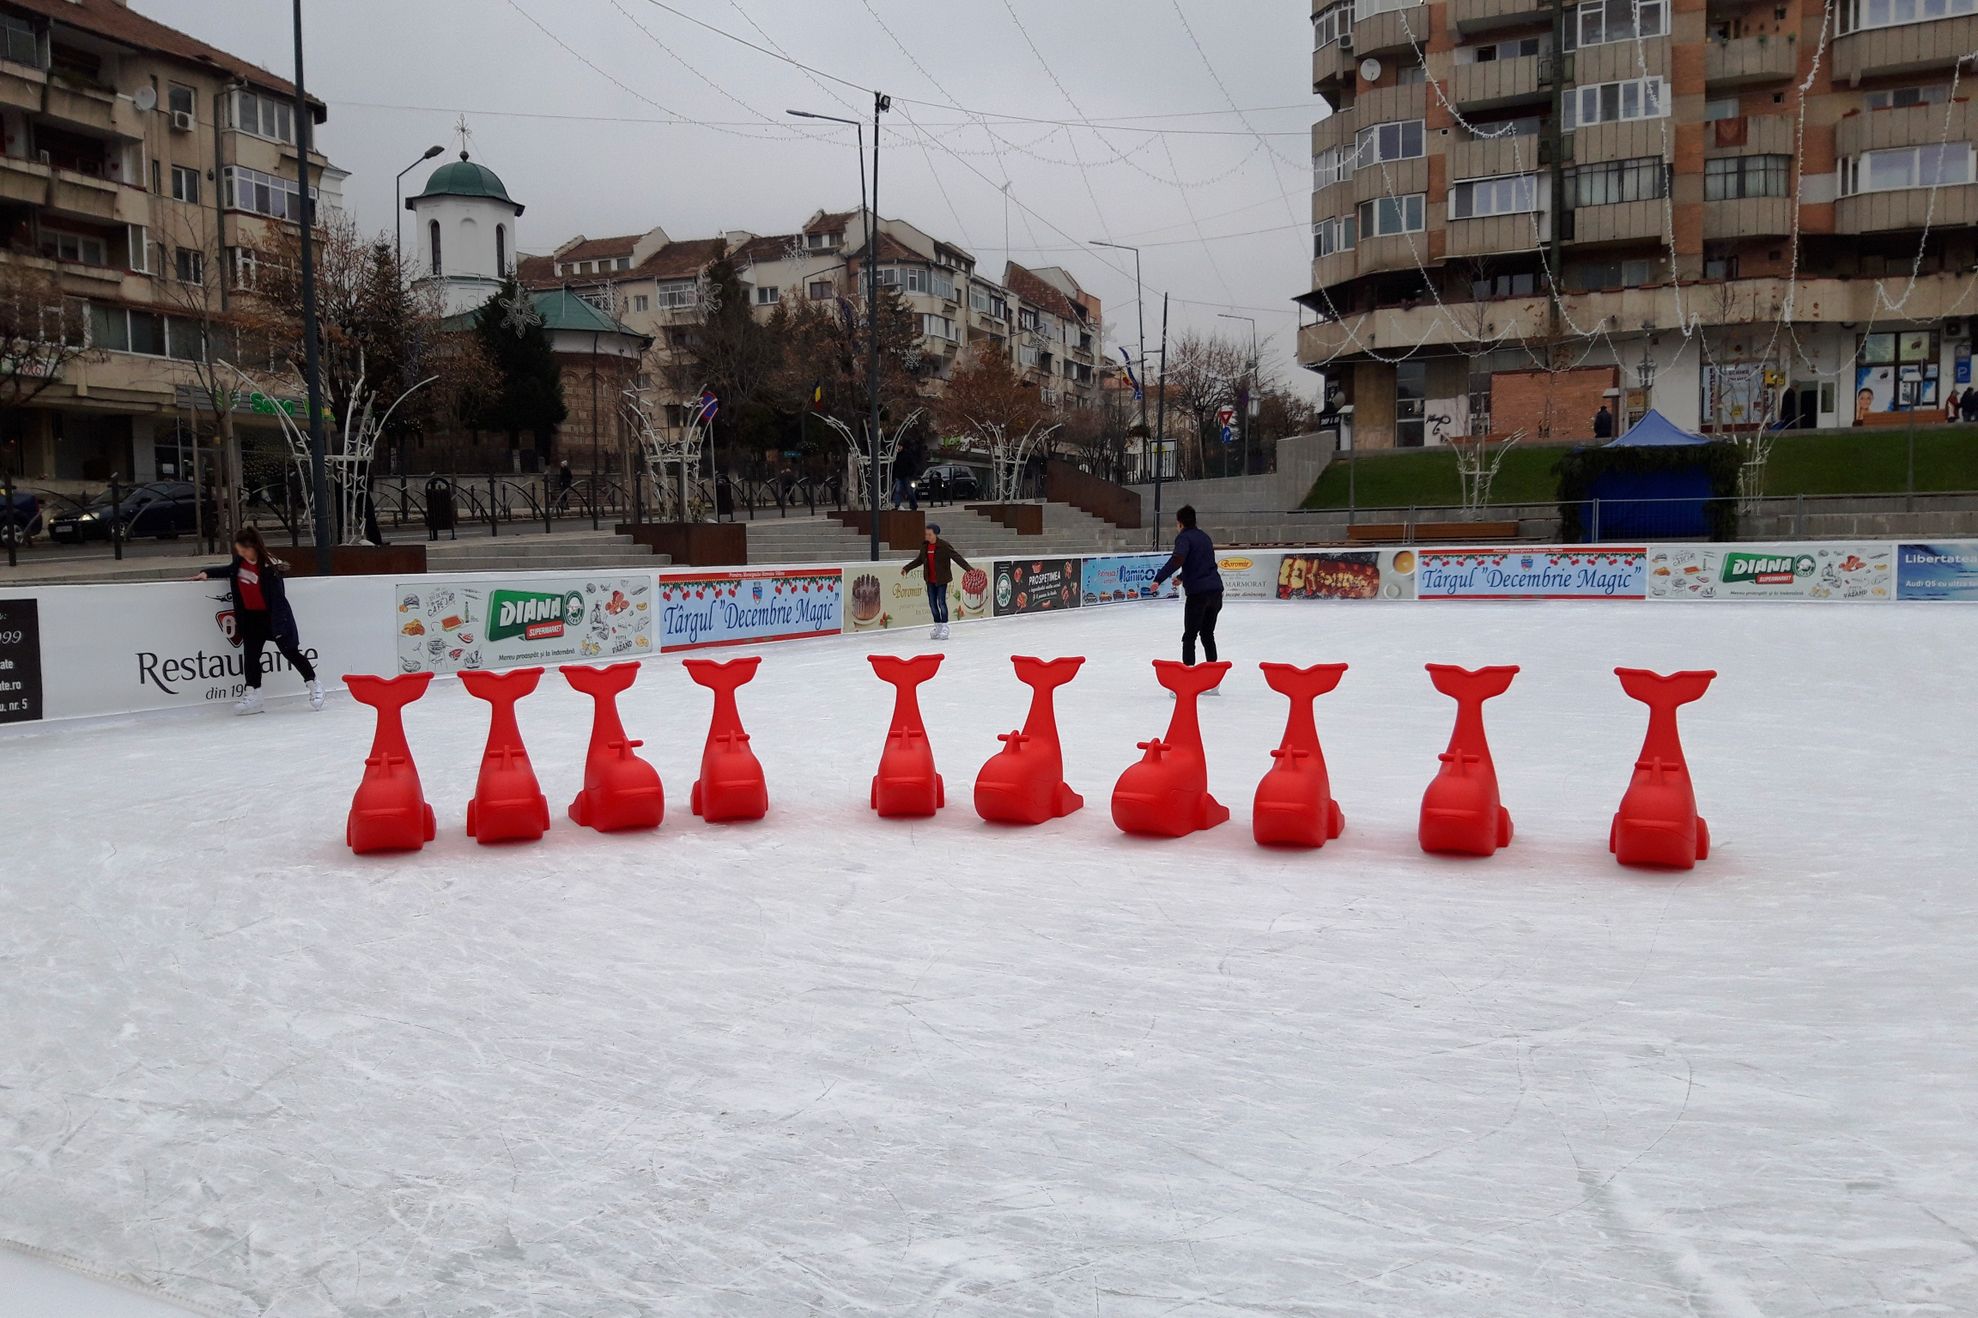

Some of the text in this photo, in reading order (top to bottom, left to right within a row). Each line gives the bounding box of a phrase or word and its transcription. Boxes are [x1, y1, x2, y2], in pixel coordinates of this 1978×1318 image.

[1732, 558, 1792, 575] DIANA
[1422, 567, 1475, 595] Târgul
[499, 597, 562, 627] DIANA
[664, 600, 717, 643] Târgul
[529, 624, 563, 638] SUPERMARKET
[136, 647, 319, 695] Restauane
[21, 697, 28, 709] 5
[205, 684, 227, 700] din
